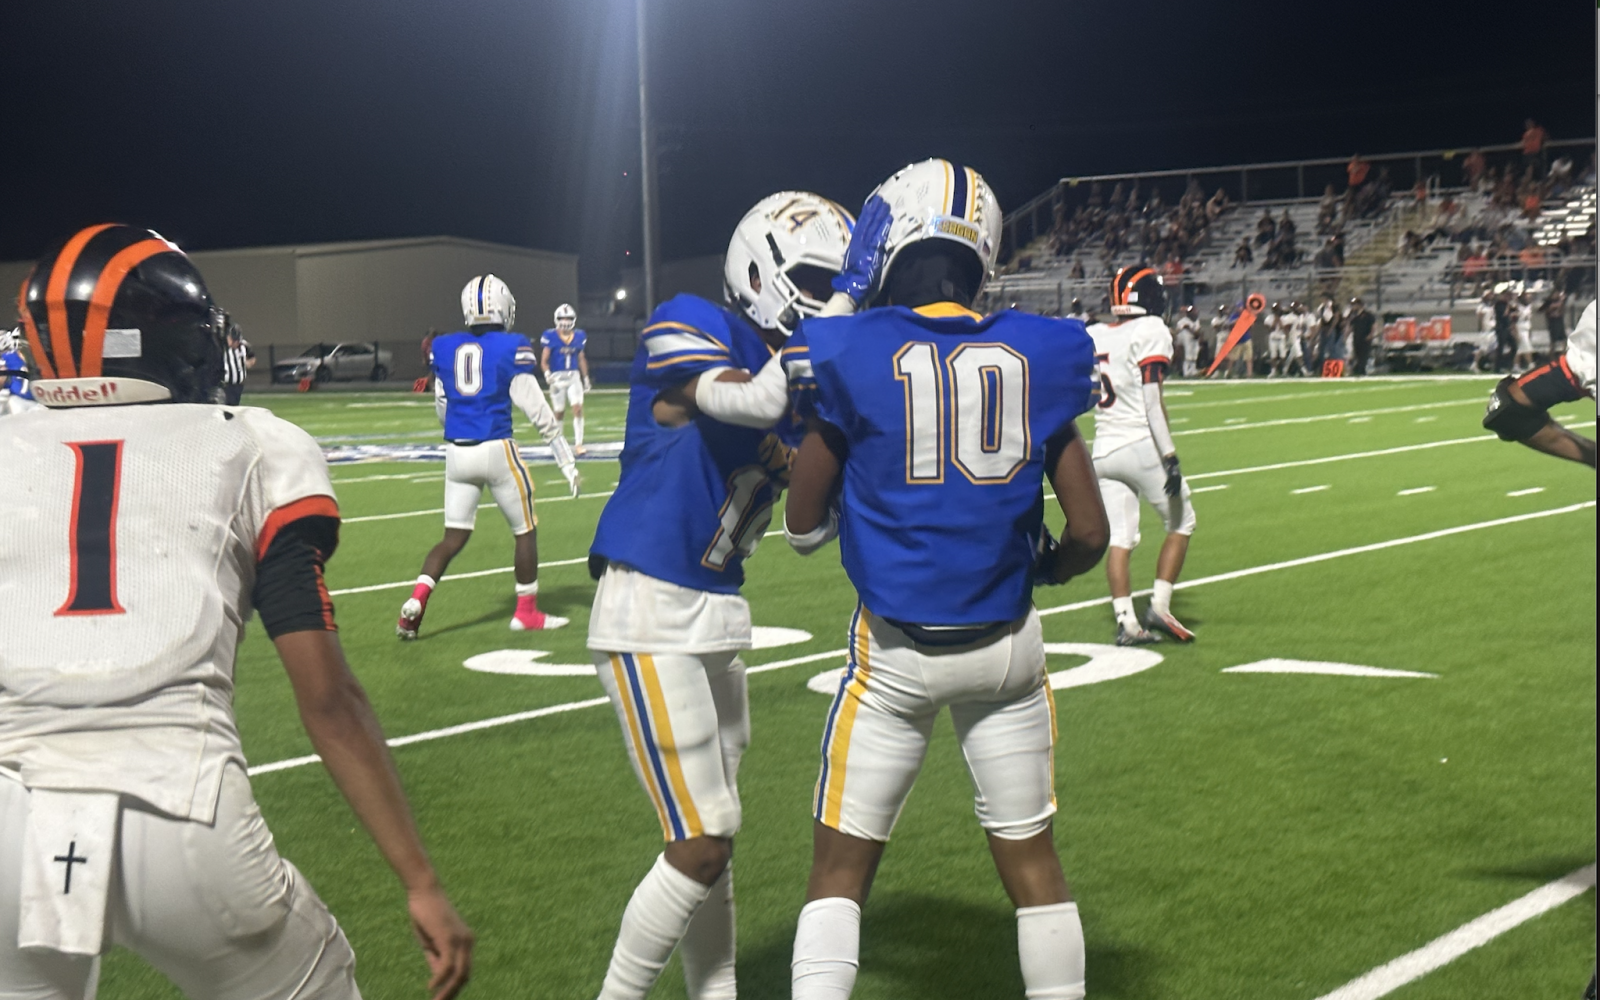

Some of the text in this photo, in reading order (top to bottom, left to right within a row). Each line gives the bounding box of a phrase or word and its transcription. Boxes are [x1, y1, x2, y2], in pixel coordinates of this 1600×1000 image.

[770, 198, 820, 234] 14
[454, 343, 483, 396] 0
[892, 341, 1031, 485] 10
[54, 439, 127, 618] 1
